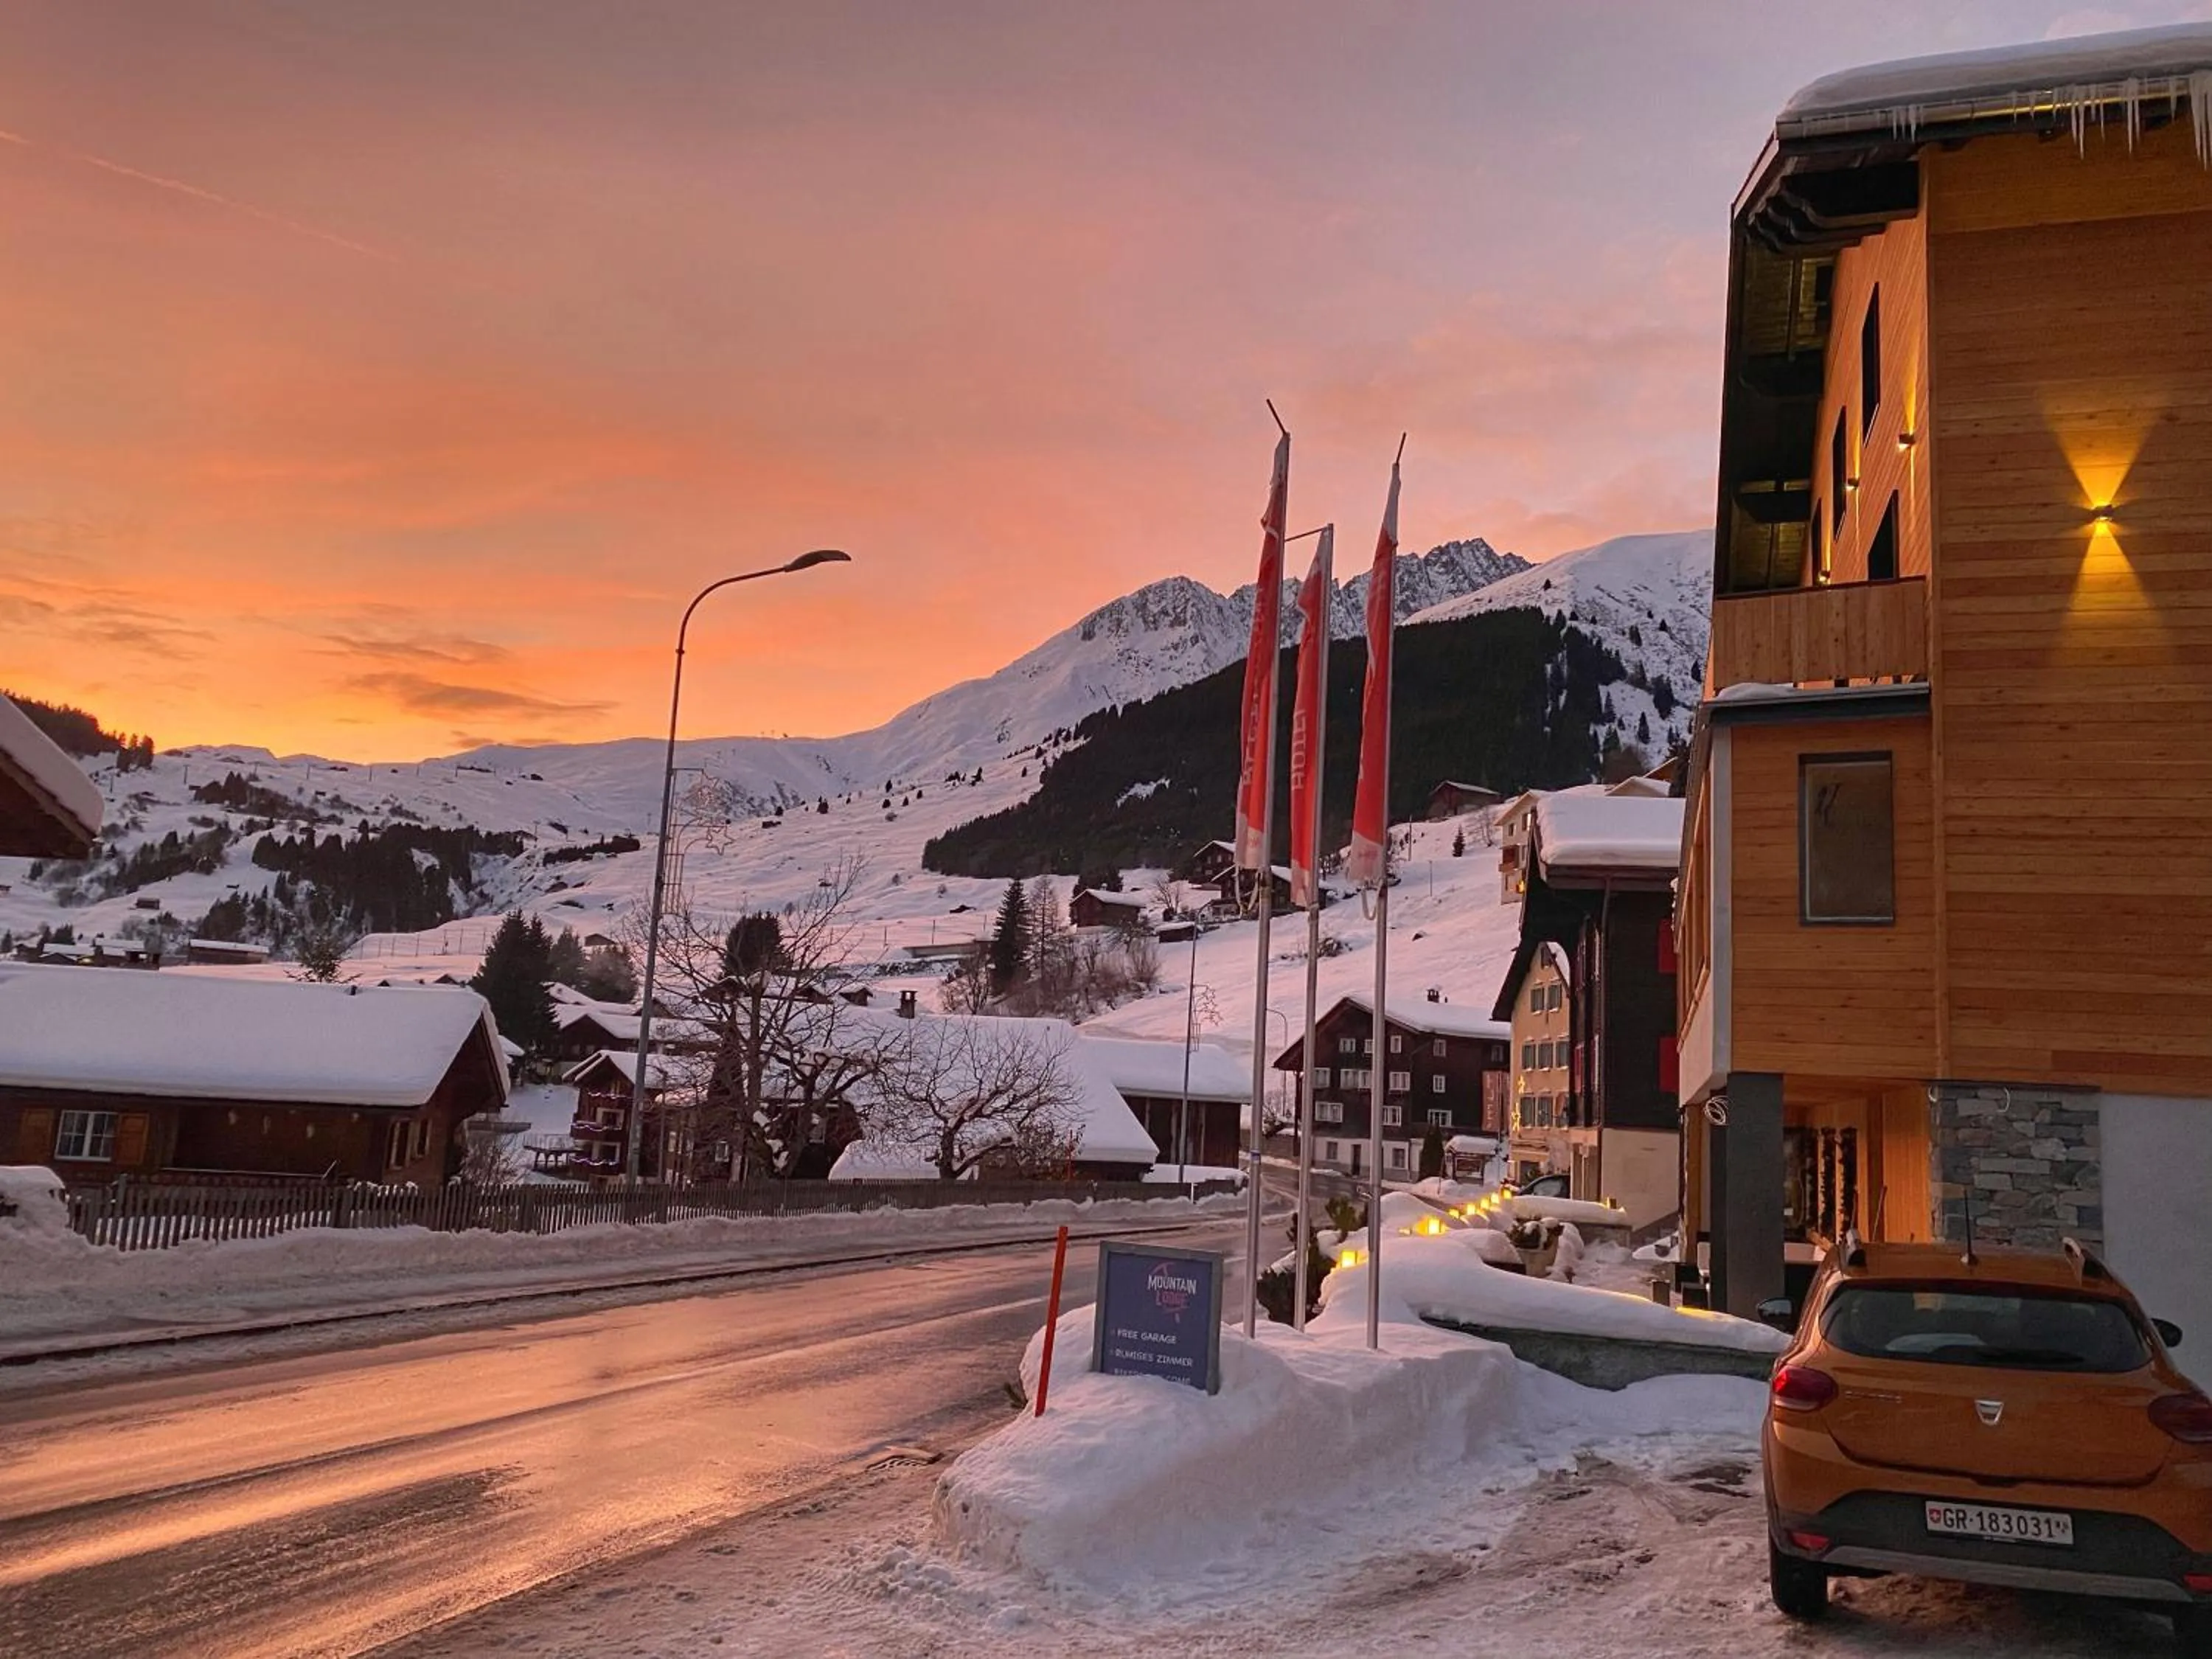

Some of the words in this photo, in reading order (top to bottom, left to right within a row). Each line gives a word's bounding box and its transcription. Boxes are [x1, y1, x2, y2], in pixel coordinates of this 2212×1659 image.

[1147, 1273, 1197, 1295] MOUNTAIN
[1117, 1329, 1139, 1339] FREE
[1141, 1332, 1177, 1344] GARAGE
[1156, 1354, 1193, 1367] ZIMMER
